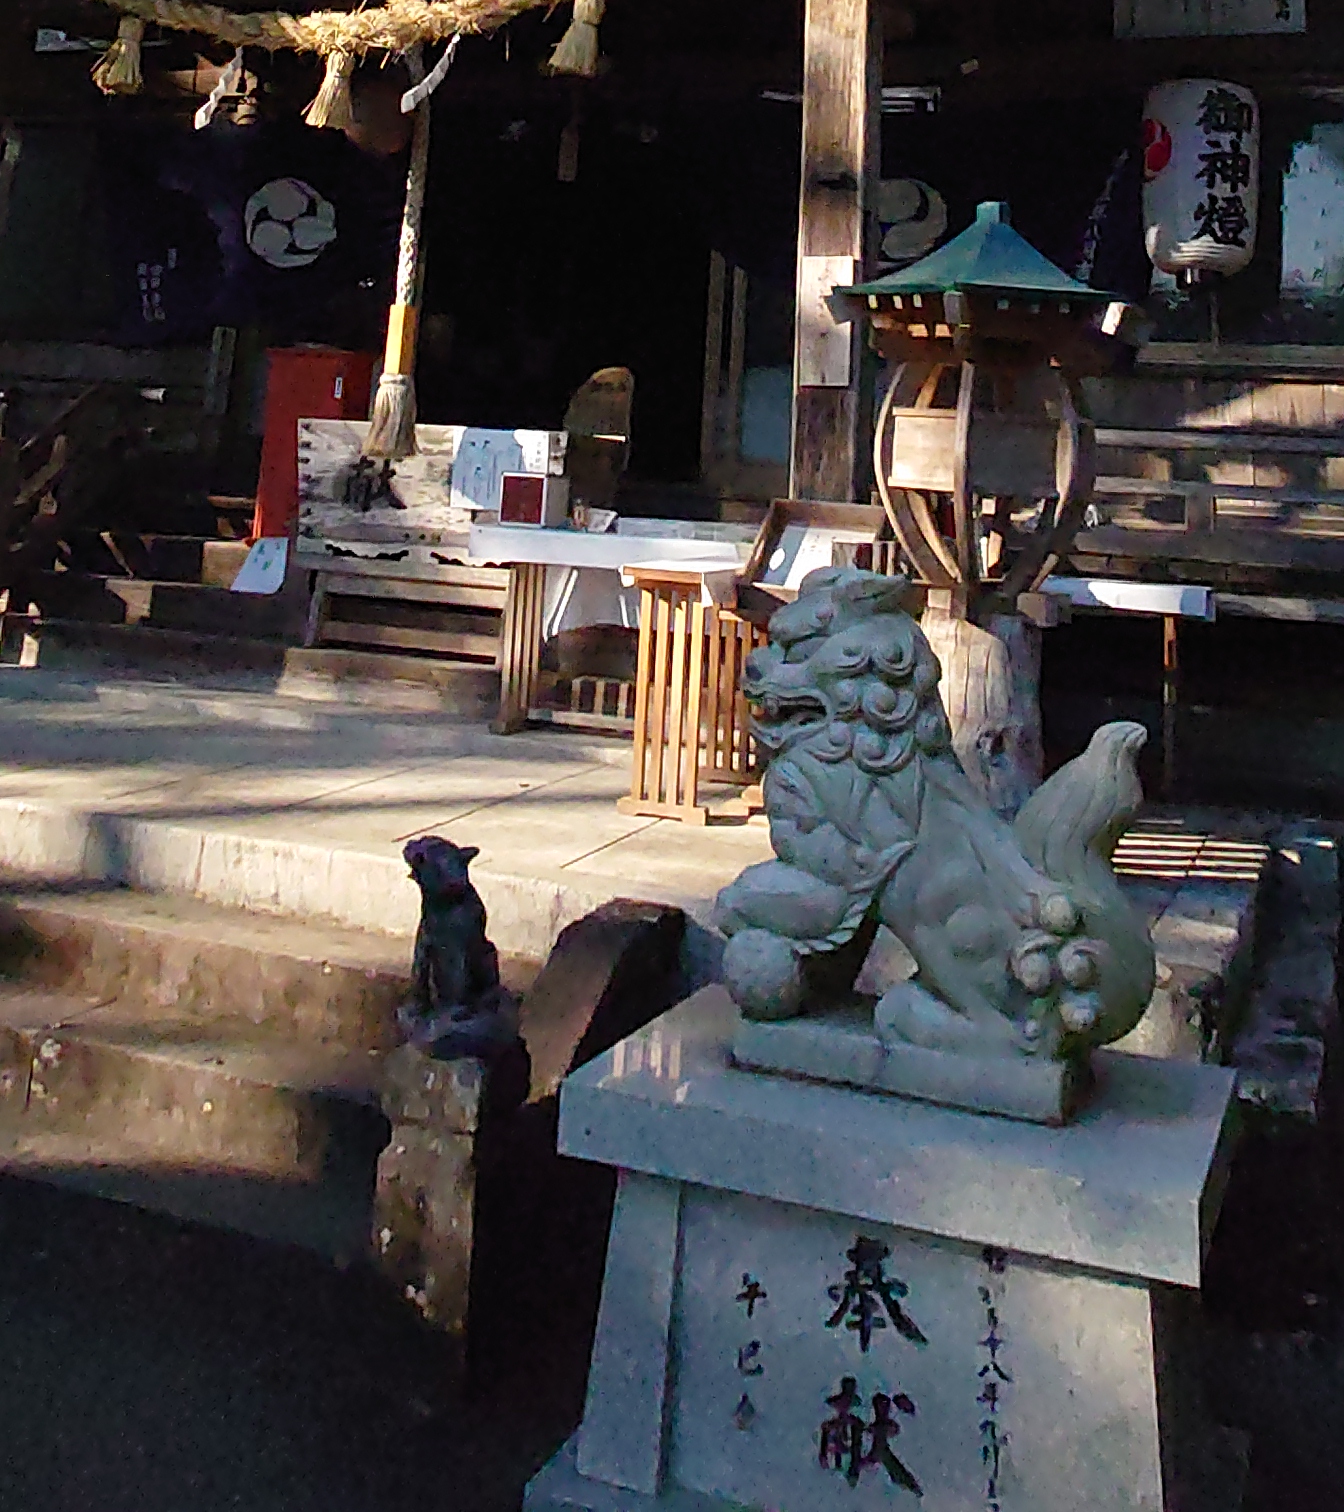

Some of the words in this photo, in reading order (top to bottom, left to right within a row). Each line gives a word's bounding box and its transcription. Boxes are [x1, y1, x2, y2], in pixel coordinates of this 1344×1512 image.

[1195, 88, 1252, 248] 御神燈
[818, 1234, 928, 1497] 奉献
